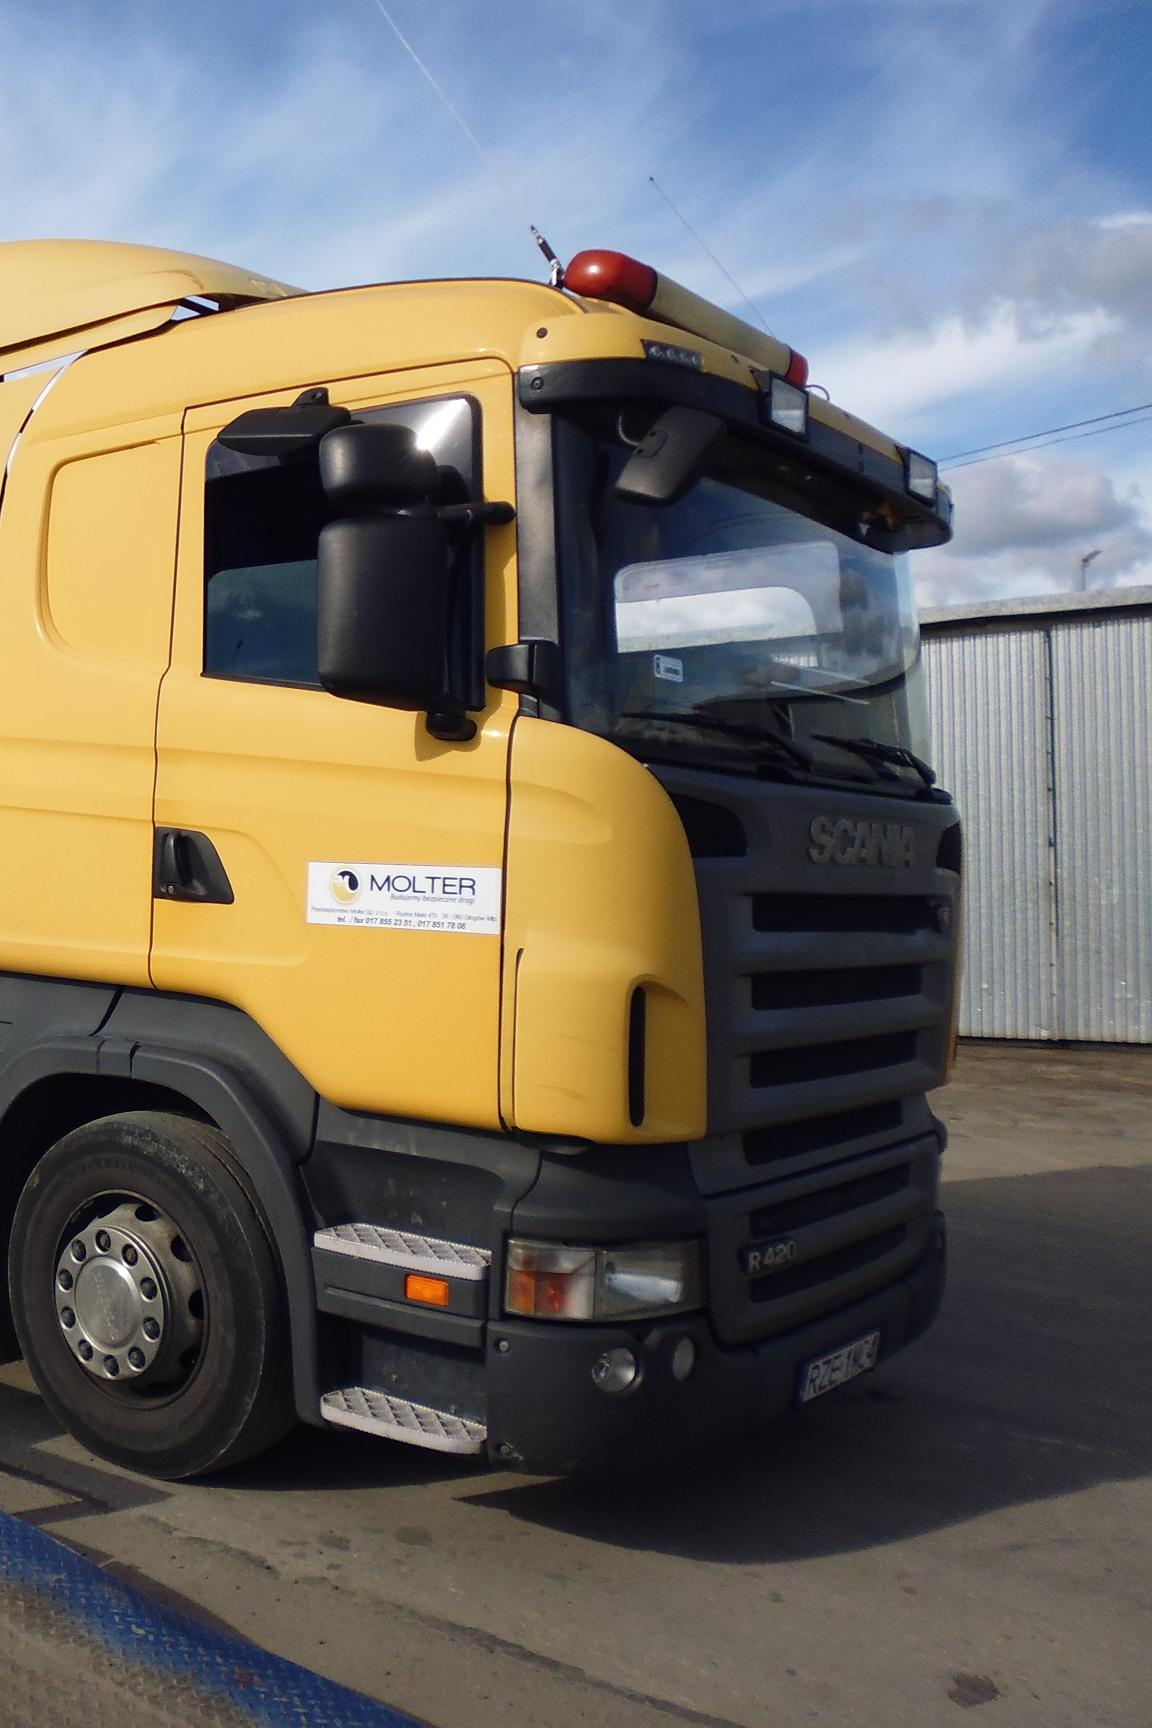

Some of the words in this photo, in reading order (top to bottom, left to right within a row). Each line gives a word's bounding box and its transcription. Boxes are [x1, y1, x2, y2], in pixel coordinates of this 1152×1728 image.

[808, 816, 919, 868] SCANIA
[370, 874, 476, 896] MOLTER
[354, 916, 364, 924] fax
[366, 917, 379, 925] 017
[380, 918, 392, 926] 855
[394, 918, 402, 926] 23
[404, 919, 412, 927] 51
[417, 920, 431, 928] 017
[432, 921, 445, 929] 851
[447, 922, 456, 930] 78
[748, 1251, 760, 1274] R
[763, 1241, 797, 1266] 420
